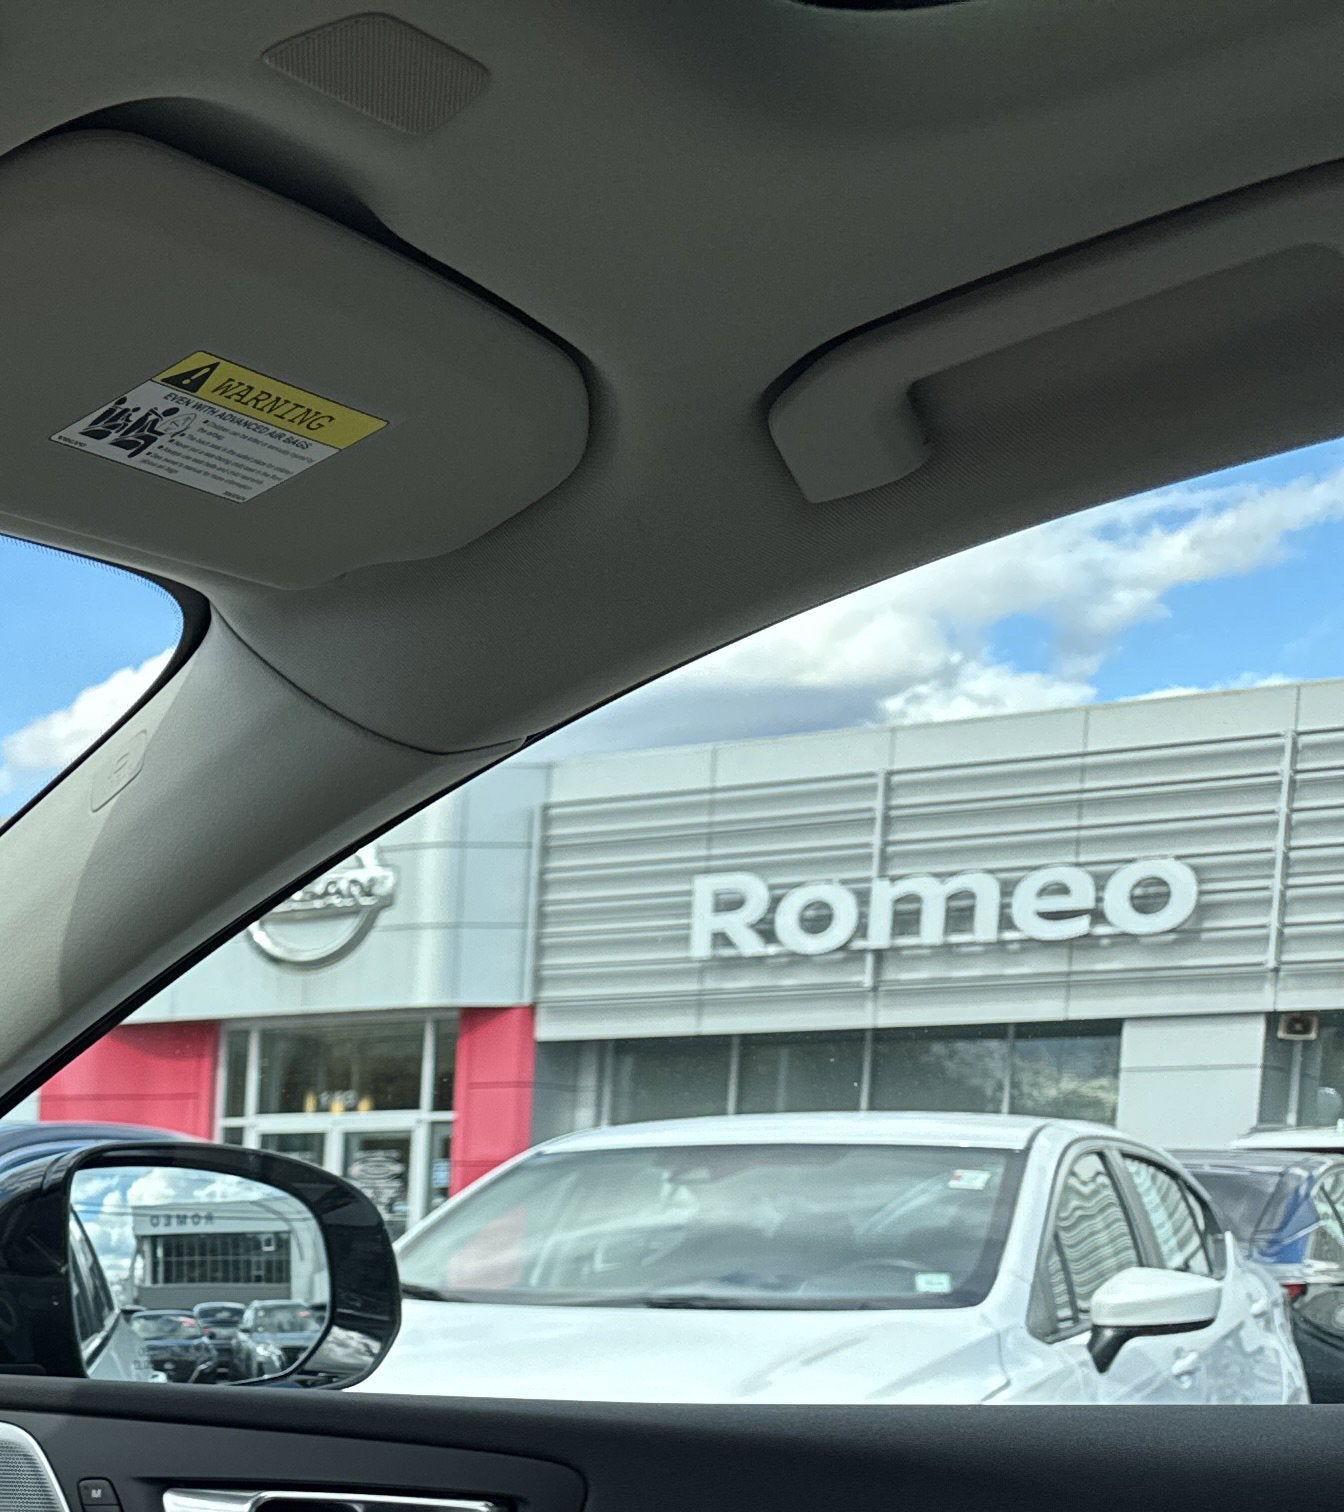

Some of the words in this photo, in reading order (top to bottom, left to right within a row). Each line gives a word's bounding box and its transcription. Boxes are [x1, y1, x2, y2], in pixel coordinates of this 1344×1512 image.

[163, 392, 195, 407] EVEN
[189, 402, 221, 415] WITH
[215, 411, 269, 433] ADVANCED
[264, 429, 289, 440] AIR
[281, 436, 312, 450] BAGS
[211, 377, 335, 431] WARNING
[689, 856, 1200, 960] Romeo
[91, 1488, 102, 1499] M
